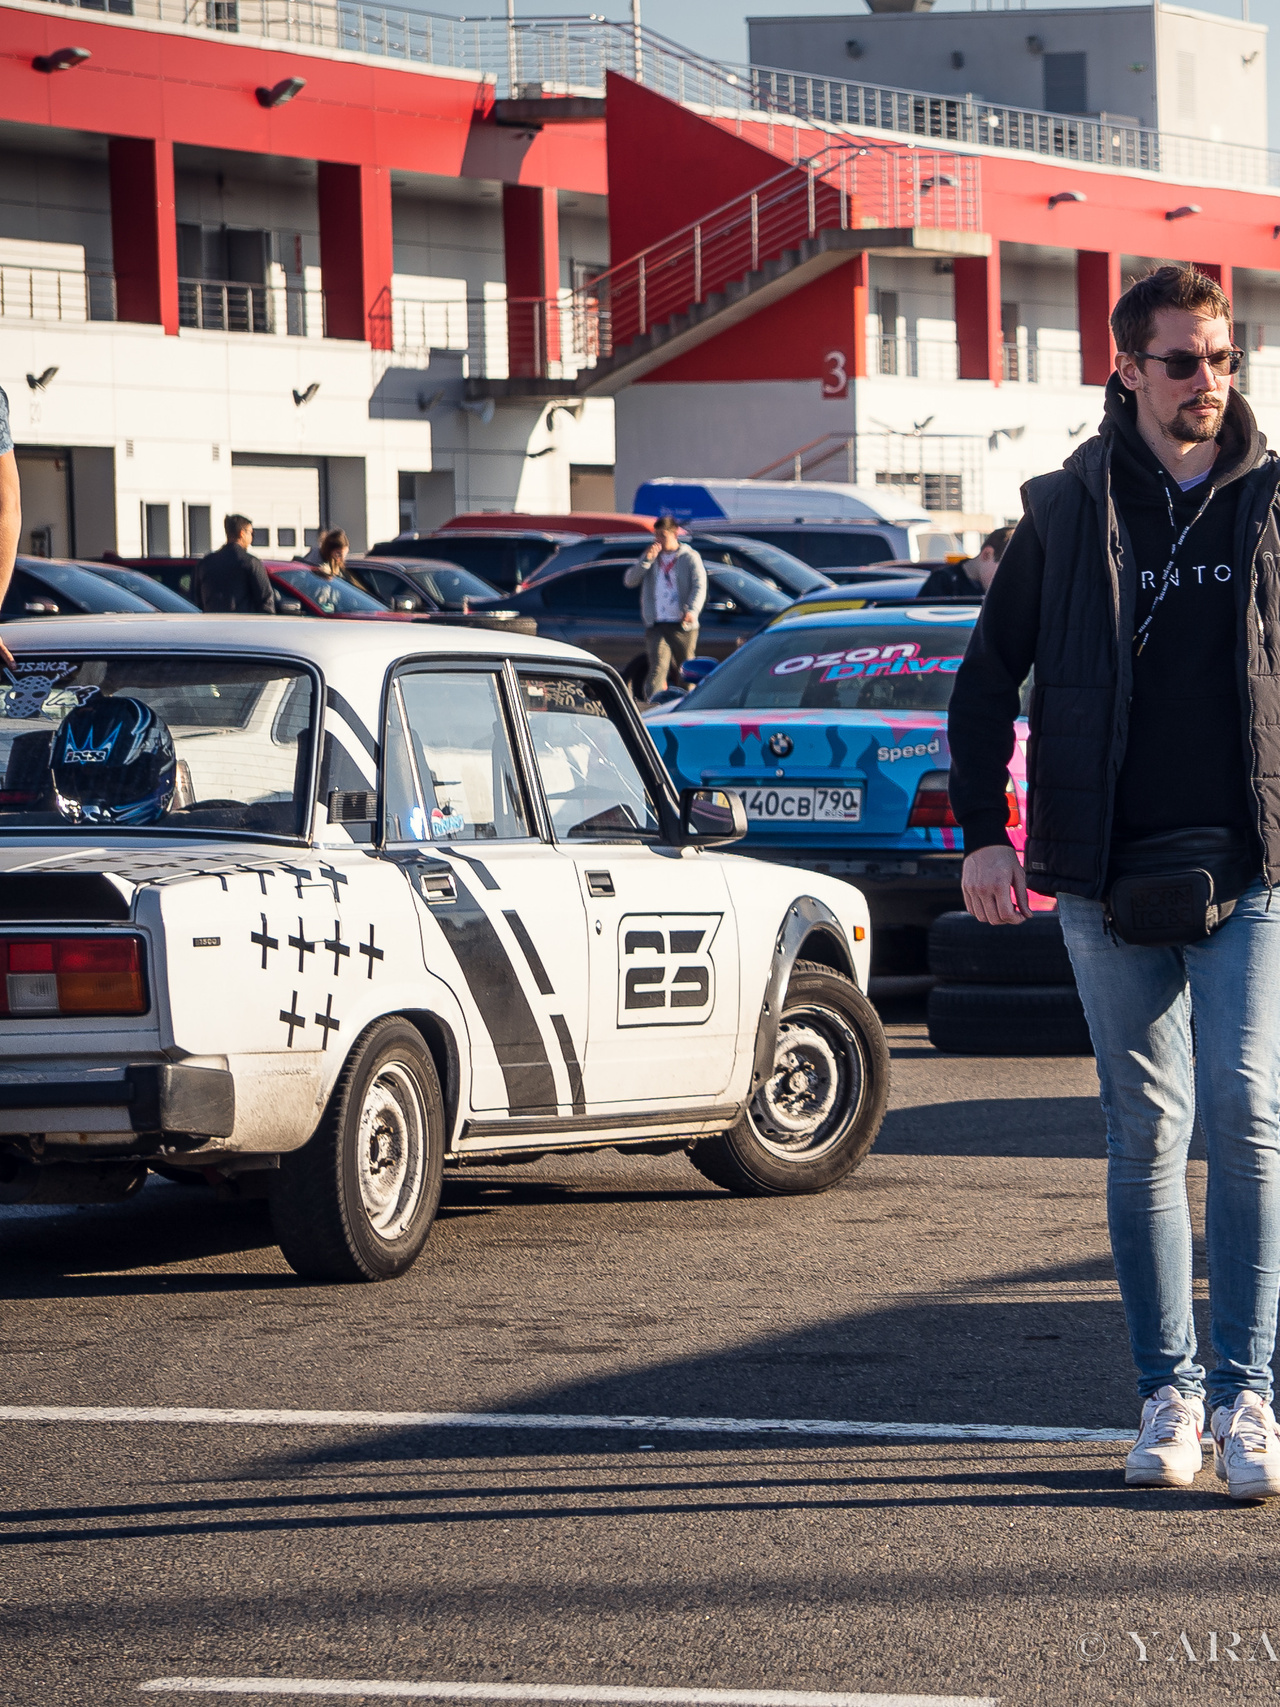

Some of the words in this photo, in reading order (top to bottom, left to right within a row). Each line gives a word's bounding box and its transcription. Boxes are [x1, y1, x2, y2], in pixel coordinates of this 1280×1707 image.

[824, 350, 846, 393] 3
[1192, 564, 1232, 585] TO
[818, 790, 855, 810] 790
[825, 808, 844, 817] RUS
